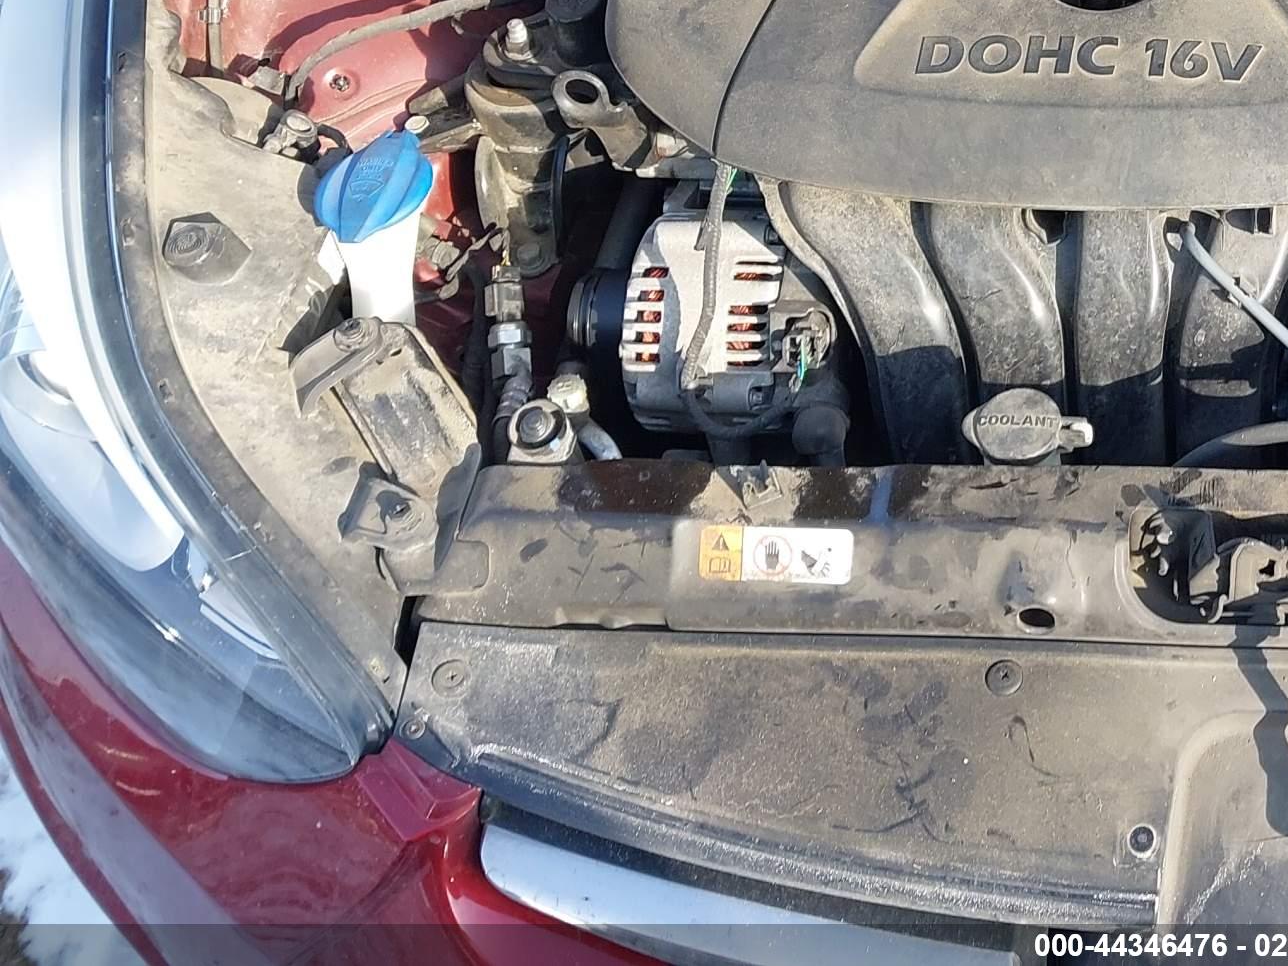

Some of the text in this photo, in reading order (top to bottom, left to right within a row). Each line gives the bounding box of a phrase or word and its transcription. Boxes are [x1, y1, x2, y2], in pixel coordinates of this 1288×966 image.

[914, 35, 1263, 82] DOHC 16V
[978, 414, 1058, 429] COOLANT
